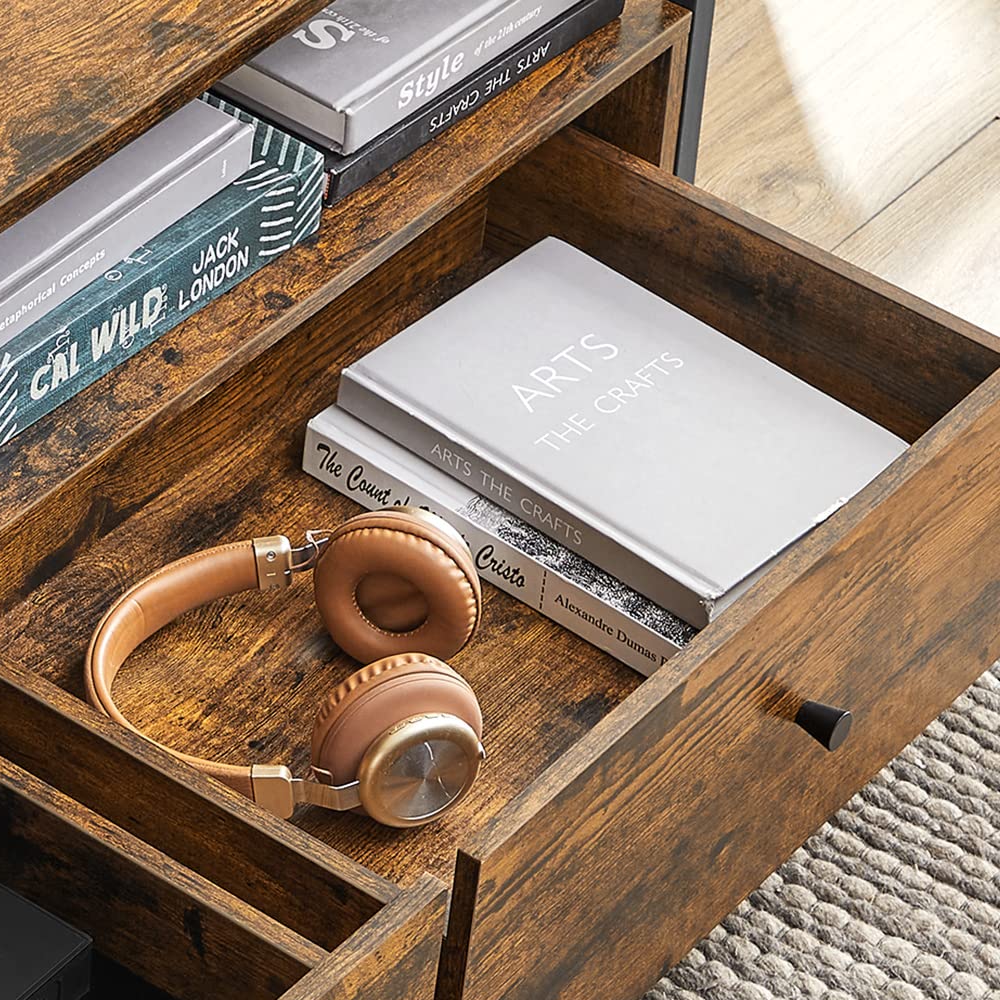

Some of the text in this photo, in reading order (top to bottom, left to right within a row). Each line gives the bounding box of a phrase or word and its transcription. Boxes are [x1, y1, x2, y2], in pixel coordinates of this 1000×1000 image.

[398, 51, 465, 110] Style
[474, 40, 484, 57] of
[485, 35, 497, 48] the
[514, 5, 543, 29] century
[429, 41, 551, 133] ARTS THE CRAFTS
[59, 248, 107, 287] Concepts
[178, 245, 250, 311] LONDON
[192, 227, 240, 275] JACK
[30, 286, 164, 401] CAL WILD
[511, 333, 619, 414] ARTS
[534, 351, 685, 451] THE CRAFTS
[316, 442, 343, 478] The
[346, 465, 392, 505] Count
[475, 544, 527, 588] Cristo
[431, 443, 583, 546] ARTS THE CRAFTS
[554, 594, 614, 636] Alexandre
[616, 629, 657, 662] Dumas
